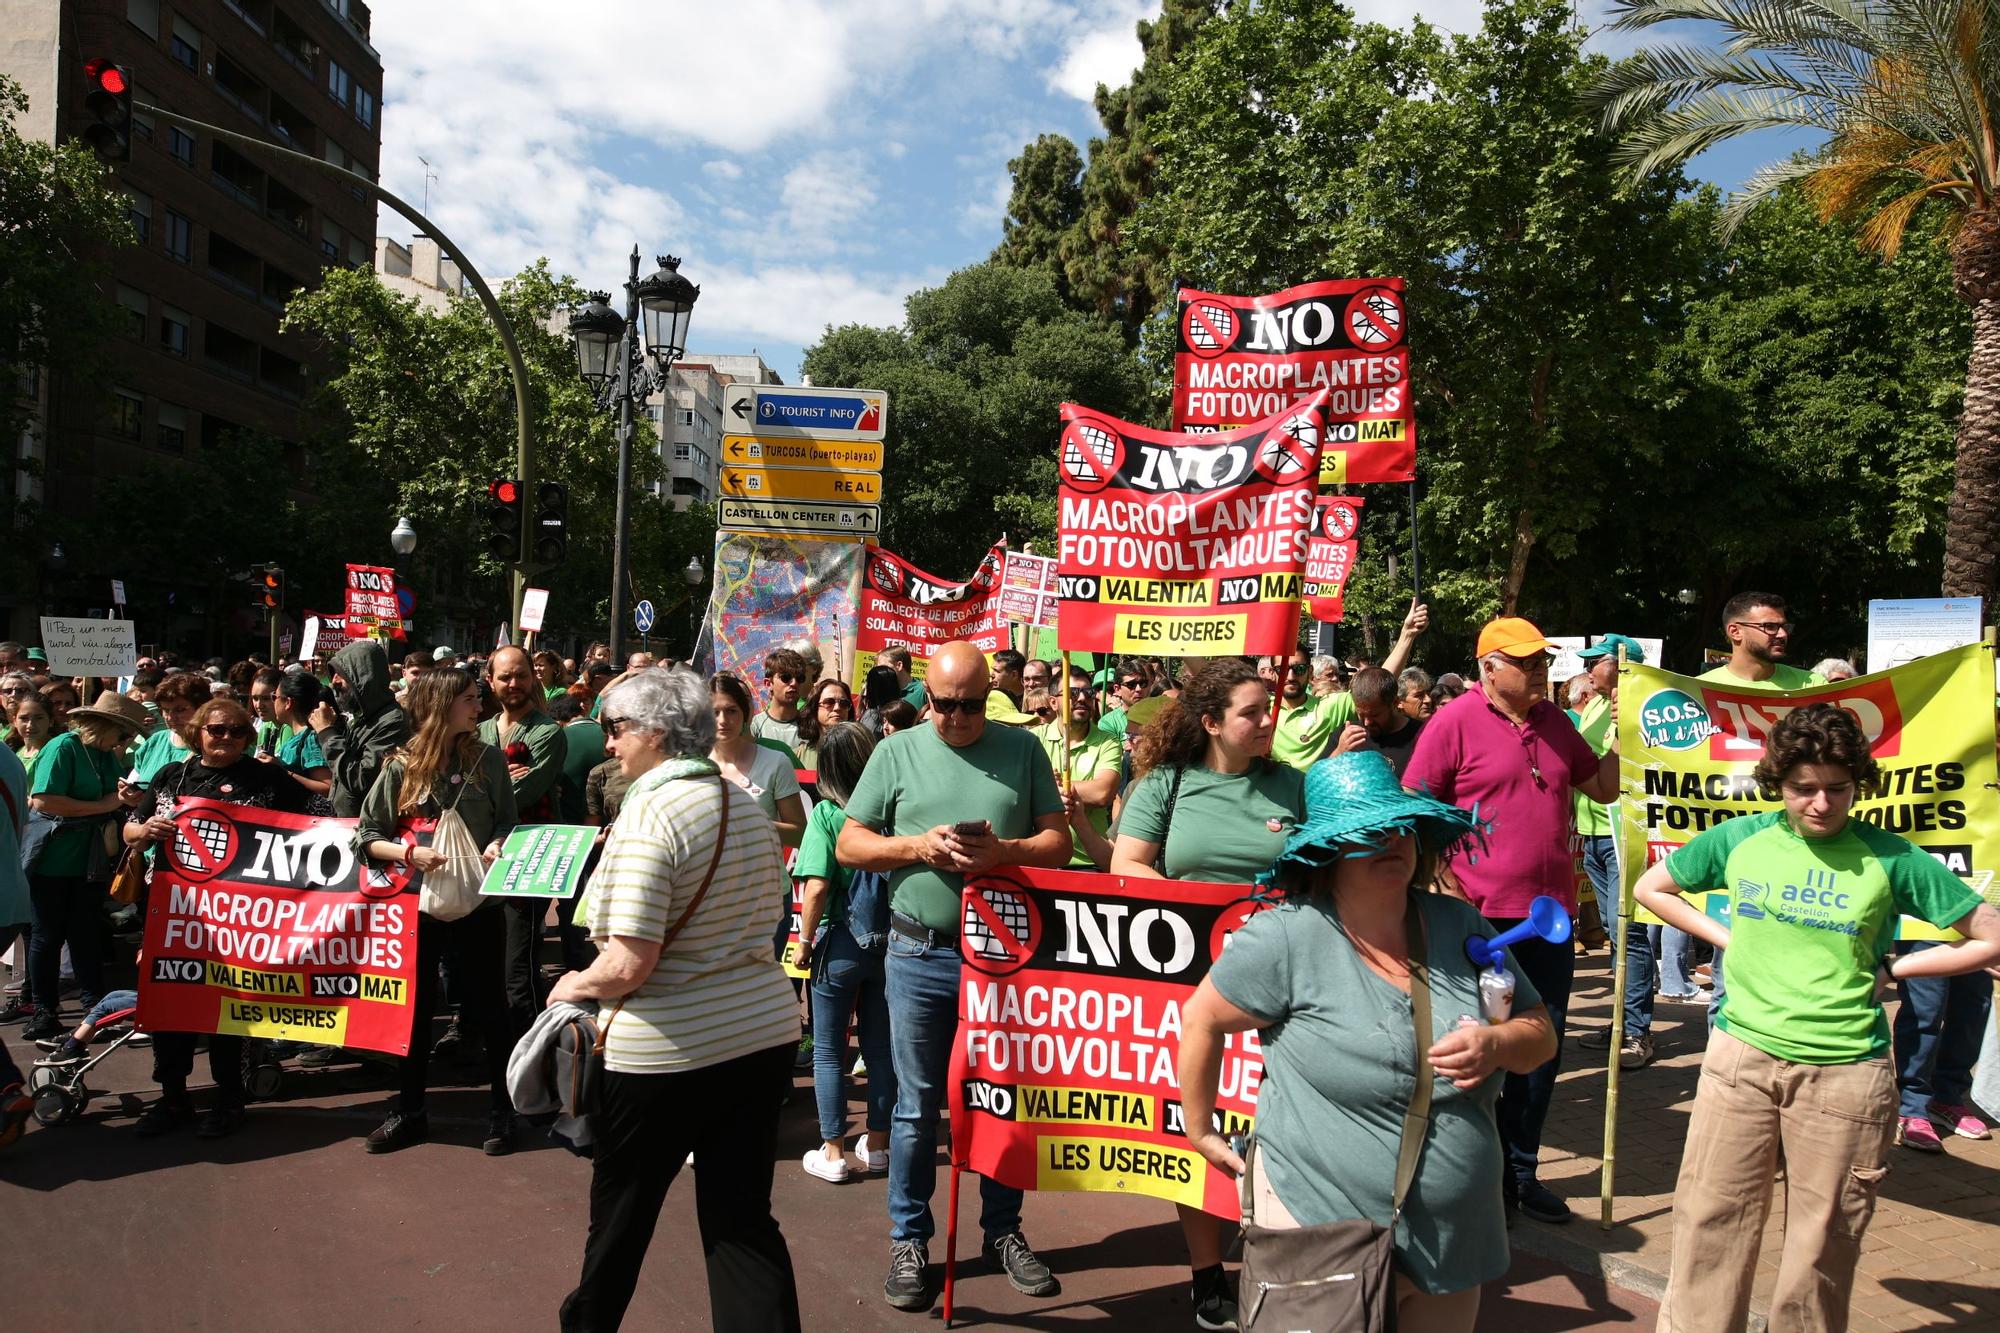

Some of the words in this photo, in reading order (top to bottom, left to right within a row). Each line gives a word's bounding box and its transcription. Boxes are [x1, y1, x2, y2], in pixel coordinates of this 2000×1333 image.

[1246, 301, 1335, 350] NO
[1189, 356, 1401, 389] MACROPLANTES
[780, 406, 826, 418] TOURIST
[830, 408, 855, 419] INFO
[1187, 387, 1401, 418] FOTOVOLQUES
[1361, 421, 1401, 440] MAT
[765, 445, 807, 458] TURCOSA
[809, 446, 877, 462] (puerto-playas)
[1130, 445, 1248, 490] NO
[834, 480, 874, 493] REAL
[725, 508, 789, 520] CASTELLON
[792, 511, 835, 522] CENTER
[1061, 488, 1314, 537] MACROPLANTES
[1061, 529, 1310, 572] FOTOVOLTAIQUES
[358, 572, 380, 590] NO
[1058, 577, 1097, 599] NO
[1106, 578, 1207, 604] VALENTIA
[1220, 578, 1259, 602] NO
[1320, 584, 1338, 596] MAT
[871, 599, 926, 621] PROJECTE
[928, 608, 941, 621] DE
[79, 626, 95, 634] un
[866, 617, 904, 633] SOLAR
[906, 624, 927, 638] QUE
[928, 626, 950, 639] VOL
[953, 617, 993, 638] ARRASAR
[1126, 620, 1162, 640] LES
[1169, 620, 1235, 642] USERES
[48, 634, 76, 648] rural
[1644, 701, 1704, 726] S.O.S.
[1638, 728, 1671, 748] Vall
[242, 830, 355, 887] NO
[502, 860, 524, 891] ARRELS
[1806, 868, 1836, 890] III
[168, 884, 404, 935] MACROPLANTES
[1781, 884, 1850, 910] aecc
[1780, 903, 1830, 919] Castellón
[1776, 912, 1797, 924] en
[1802, 917, 1861, 936] marcha
[164, 919, 403, 969] FOTOVOLTAIQUES
[1054, 899, 1196, 975] NO
[155, 959, 203, 981] NO
[210, 965, 300, 994] VALENTIA
[314, 975, 358, 995] NO
[364, 977, 402, 1000] MAT
[231, 1003, 264, 1022] LES
[269, 1006, 337, 1029] USERES
[966, 1082, 1013, 1117] NO
[1022, 1088, 1148, 1126] VALENTIA
[1050, 1143, 1090, 1170] LES
[1099, 1146, 1192, 1184] USERES
